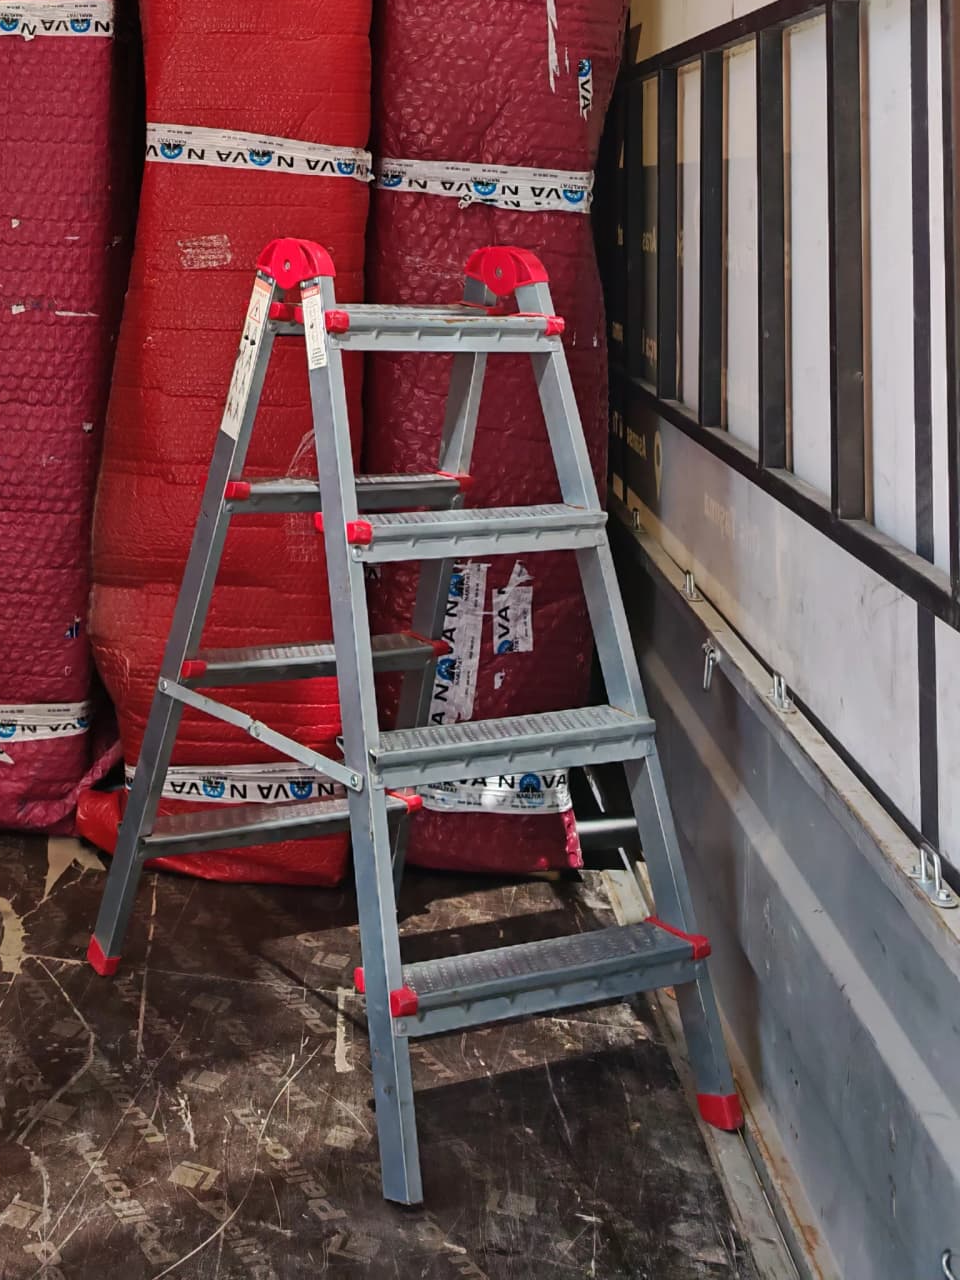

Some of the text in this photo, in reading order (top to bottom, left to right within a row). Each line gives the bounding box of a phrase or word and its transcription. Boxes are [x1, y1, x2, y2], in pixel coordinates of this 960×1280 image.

[40, 18, 111, 34] NOVA
[146, 142, 206, 161] NOV
[216, 149, 294, 169] NOVA
[440, 181, 519, 197] NOVA
[170, 779, 248, 800] NOVA
[257, 780, 335, 801] NOVA
[498, 771, 568, 796] NOVA
